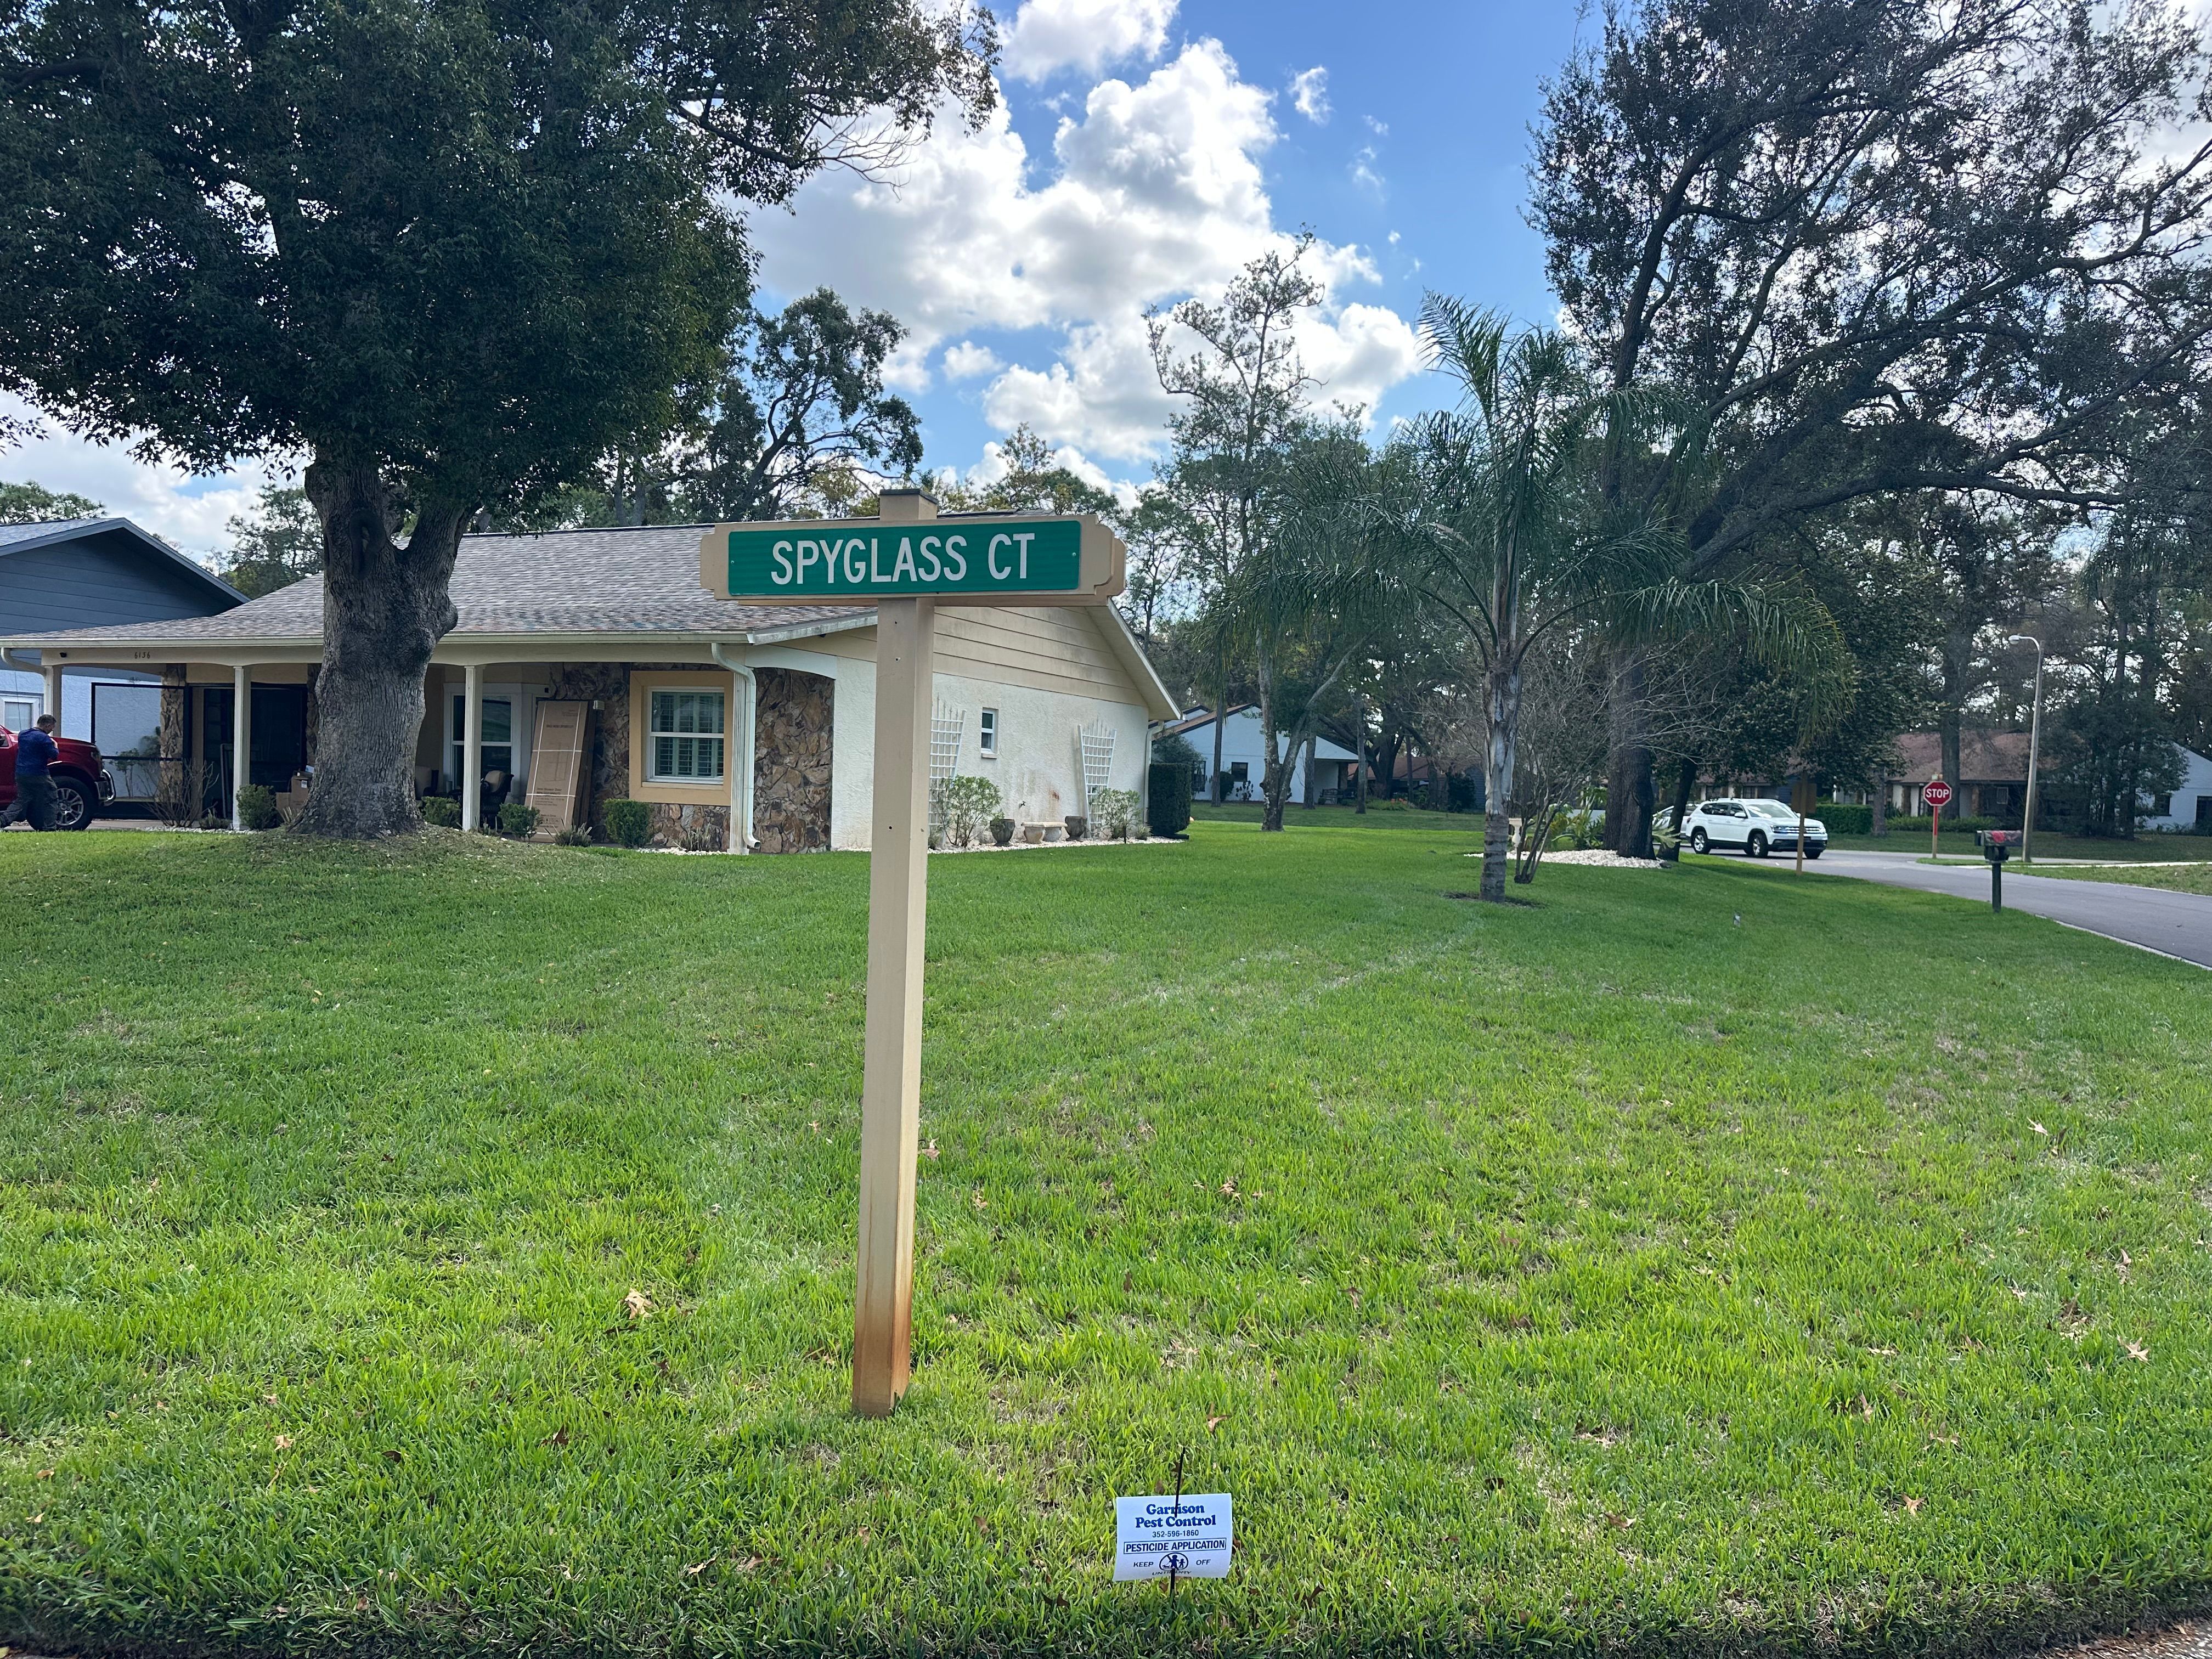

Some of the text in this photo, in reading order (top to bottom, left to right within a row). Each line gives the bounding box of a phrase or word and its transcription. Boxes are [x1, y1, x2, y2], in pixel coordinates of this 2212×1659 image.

[771, 533, 1035, 585] SPYGLASS CT
[1926, 788, 1949, 798] STOP
[1135, 1515, 1216, 1528] Pest Control
[1152, 1530, 1199, 1538] 352-596-1860
[1126, 1540, 1225, 1552] PESTICIDE APPLICATION
